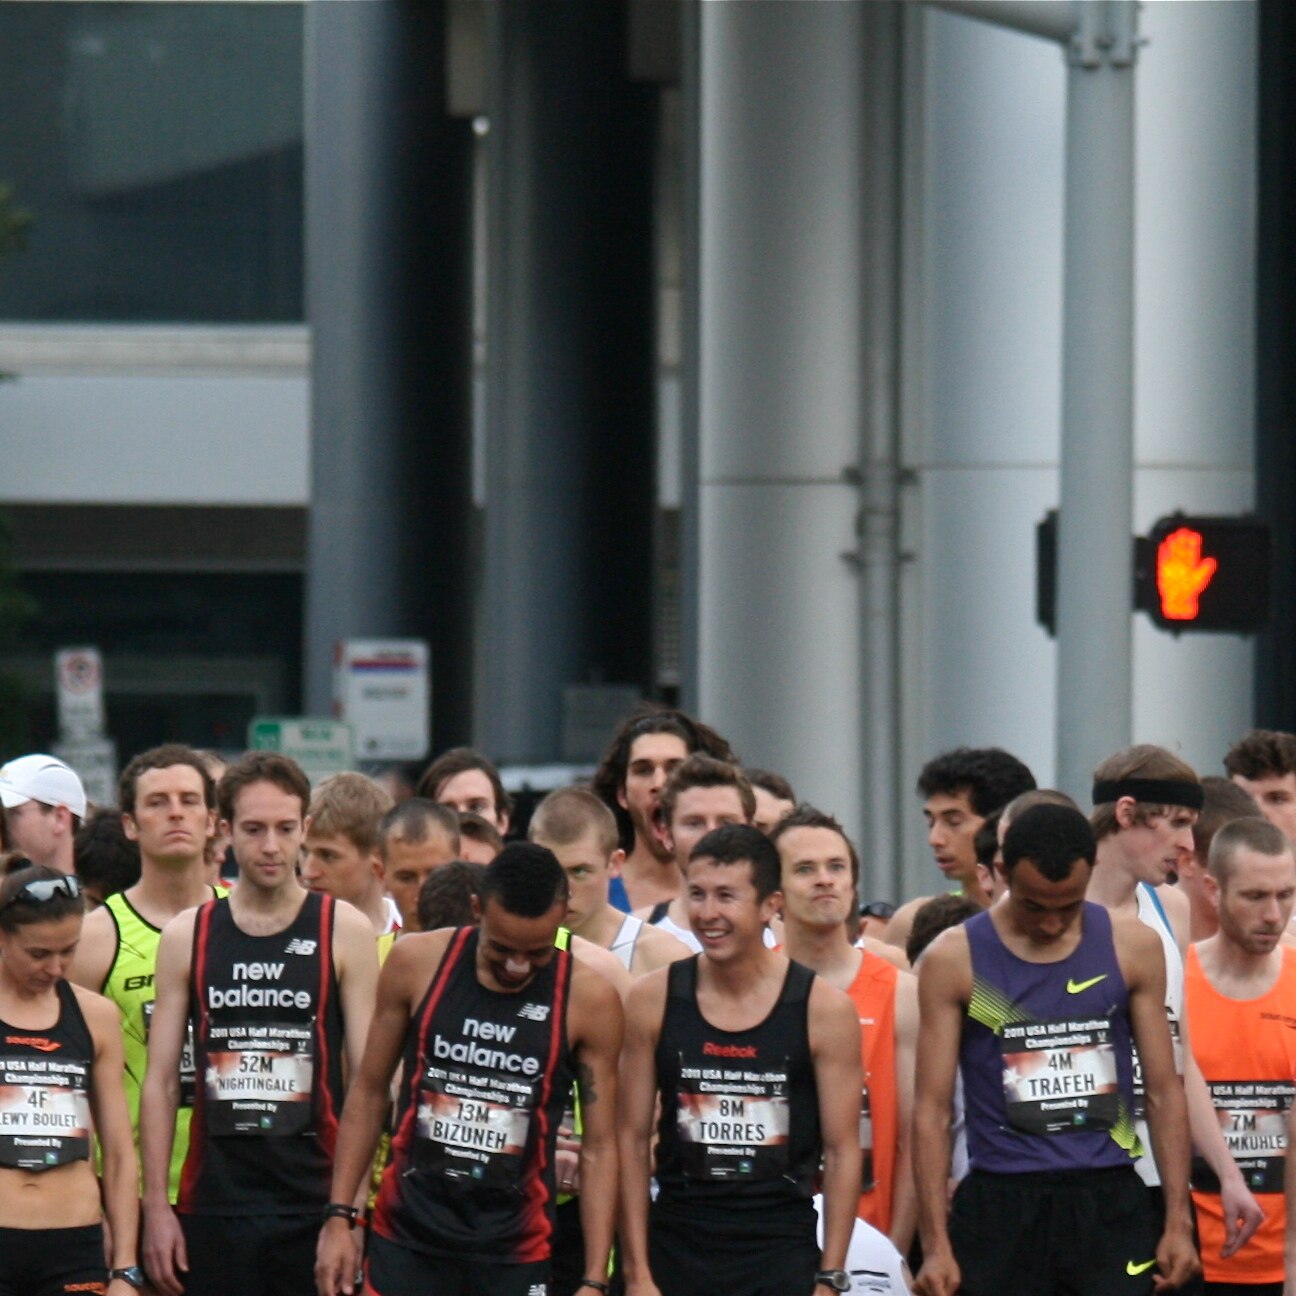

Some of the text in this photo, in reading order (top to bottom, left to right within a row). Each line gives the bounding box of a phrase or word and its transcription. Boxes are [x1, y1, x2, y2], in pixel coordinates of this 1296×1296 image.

[232, 962, 285, 981] new
[208, 984, 311, 1009] balance
[210, 1027, 311, 1039] 2011 USA Half Marathon
[462, 1018, 517, 1043] new
[1004, 1020, 1109, 1038] 2011 USA Half Marathon
[227, 1039, 290, 1051] Championships
[1025, 1034, 1091, 1048] Championships
[434, 1034, 540, 1076] balance
[703, 1042, 758, 1058] Reebok
[6, 1060, 27, 1072] USA
[28, 1061, 46, 1072] Half
[48, 1062, 86, 1075] Marathon
[239, 1055, 273, 1073] 52M
[1048, 1053, 1072, 1070] 4M
[4, 1072, 70, 1086] Championships
[427, 1067, 447, 1079] 2011
[468, 1075, 488, 1087] Half
[489, 1079, 532, 1095] Marathon
[681, 1068, 787, 1082] 2011 USA Half Marathon
[218, 1077, 295, 1093] NIGHTINGALE
[699, 1082, 766, 1095] Championships
[1028, 1074, 1095, 1097] TRAFEH
[1213, 1085, 1296, 1095] USA Half Marathon
[27, 1091, 48, 1108] 4F
[445, 1083, 510, 1104] Championships
[232, 1102, 277, 1113] Presented By
[457, 1102, 489, 1123] 13M
[719, 1100, 744, 1117] 8M
[1040, 1099, 1089, 1111] Presented By
[33, 1113, 77, 1128] BOULET
[1231, 1115, 1256, 1131] 7M
[432, 1121, 507, 1150] BIZUNEH
[700, 1122, 765, 1141] TORRES
[14, 1137, 62, 1149] Presented By
[1225, 1134, 1285, 1150] MKUHLE
[707, 1147, 756, 1156] Presented By
